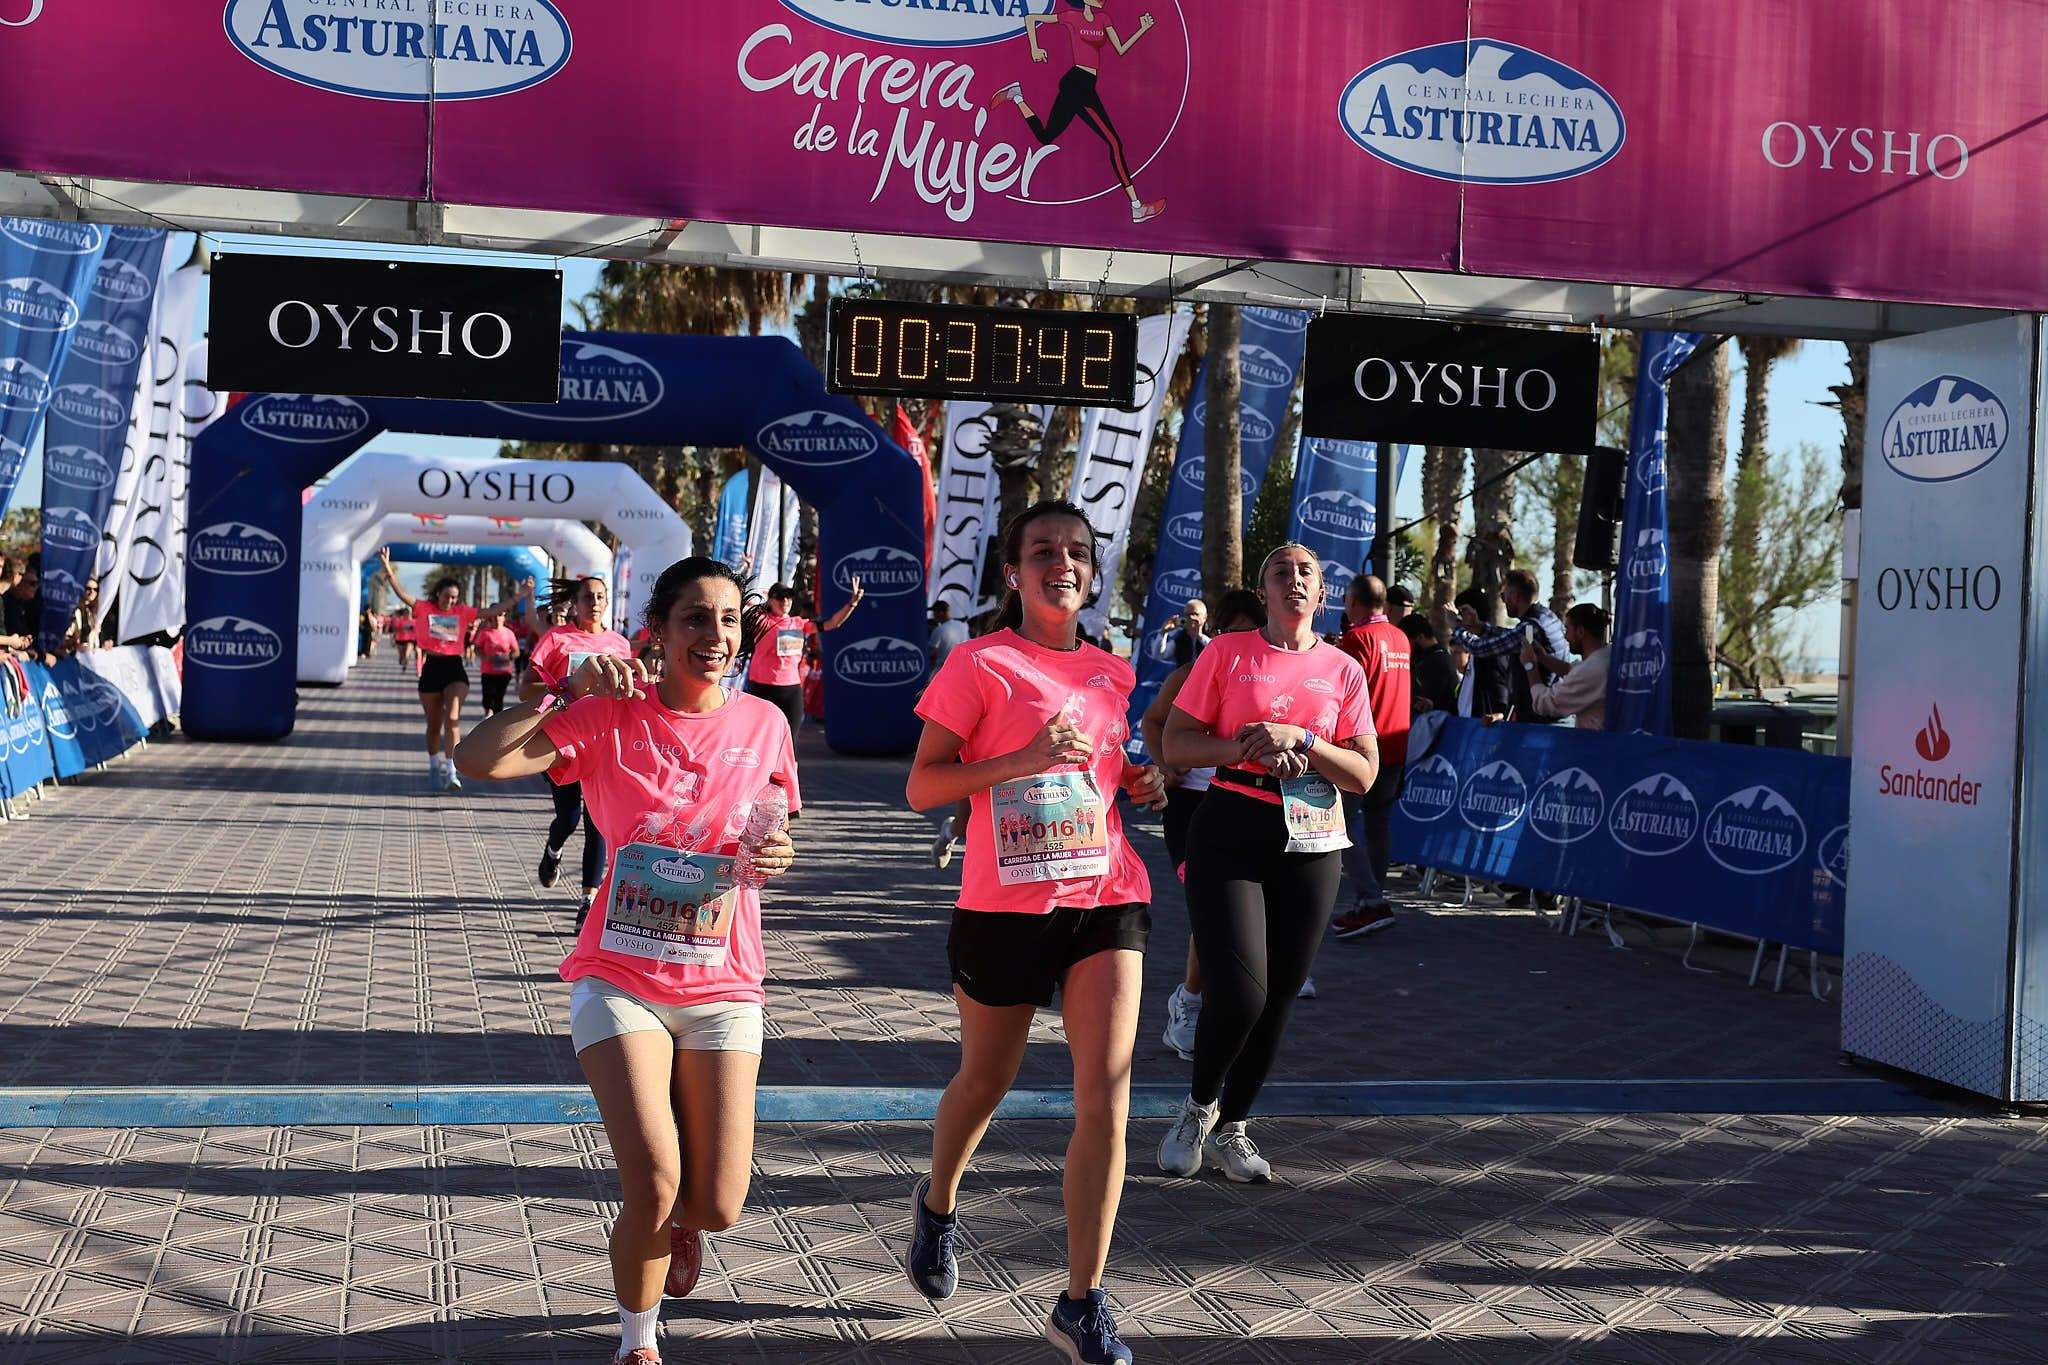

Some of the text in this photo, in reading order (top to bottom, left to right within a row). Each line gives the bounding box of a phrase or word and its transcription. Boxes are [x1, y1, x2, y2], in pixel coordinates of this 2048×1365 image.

[251, 0, 546, 67] ASTURIANA
[1079, 27, 1105, 38] OYSHO
[737, 23, 978, 109] Carrera
[1407, 83, 1595, 112] CENTRAL LECHERA
[793, 103, 879, 158] de la
[1360, 83, 1603, 154] ASTURIANA
[1761, 120, 1970, 180] OYSHO
[870, 106, 1061, 224] Mujer
[267, 299, 513, 360] OYSHO
[849, 315, 1114, 390] 00:37:42
[560, 378, 649, 403] RIANA
[1354, 356, 1558, 412] OYSHO
[249, 404, 359, 430] ASTURIANA
[1908, 407, 1996, 426] CENTRAL LECHERA
[767, 431, 871, 452] ASTURIANA
[1888, 419, 1999, 459] ASTURIANA
[418, 467, 575, 504] OYSHO
[321, 499, 371, 511] OYSHO
[617, 507, 665, 520] OYSHO
[193, 540, 281, 564] ASTURIANA
[1877, 564, 2001, 612] OYSHO
[189, 633, 275, 657] ASTURIANA
[840, 655, 921, 674] ASTURIANA
[1402, 777, 1452, 807] ASTURIANA
[1879, 764, 1982, 806] Santander
[1462, 783, 1521, 817] ASTURIANA
[1533, 791, 1597, 827] ASTURIANA
[1031, 819, 1075, 839] 016
[1613, 801, 1691, 839] ASTURIANA
[1043, 842, 1065, 852] 4525
[1708, 812, 1793, 858] ASTURIANA
[1003, 856, 1032, 865] CARRERA
[1042, 853, 1051, 861] LA
[1051, 849, 1072, 860] MUJER
[1076, 848, 1102, 857] VALENCIA
[654, 863, 702, 881] ASTURIANA
[1010, 866, 1047, 878] OYSHO
[649, 897, 698, 920] 016
[611, 922, 721, 946] CARRERA DE LA MUJER VALENCIA
[615, 936, 715, 960] OYSHO Santander
